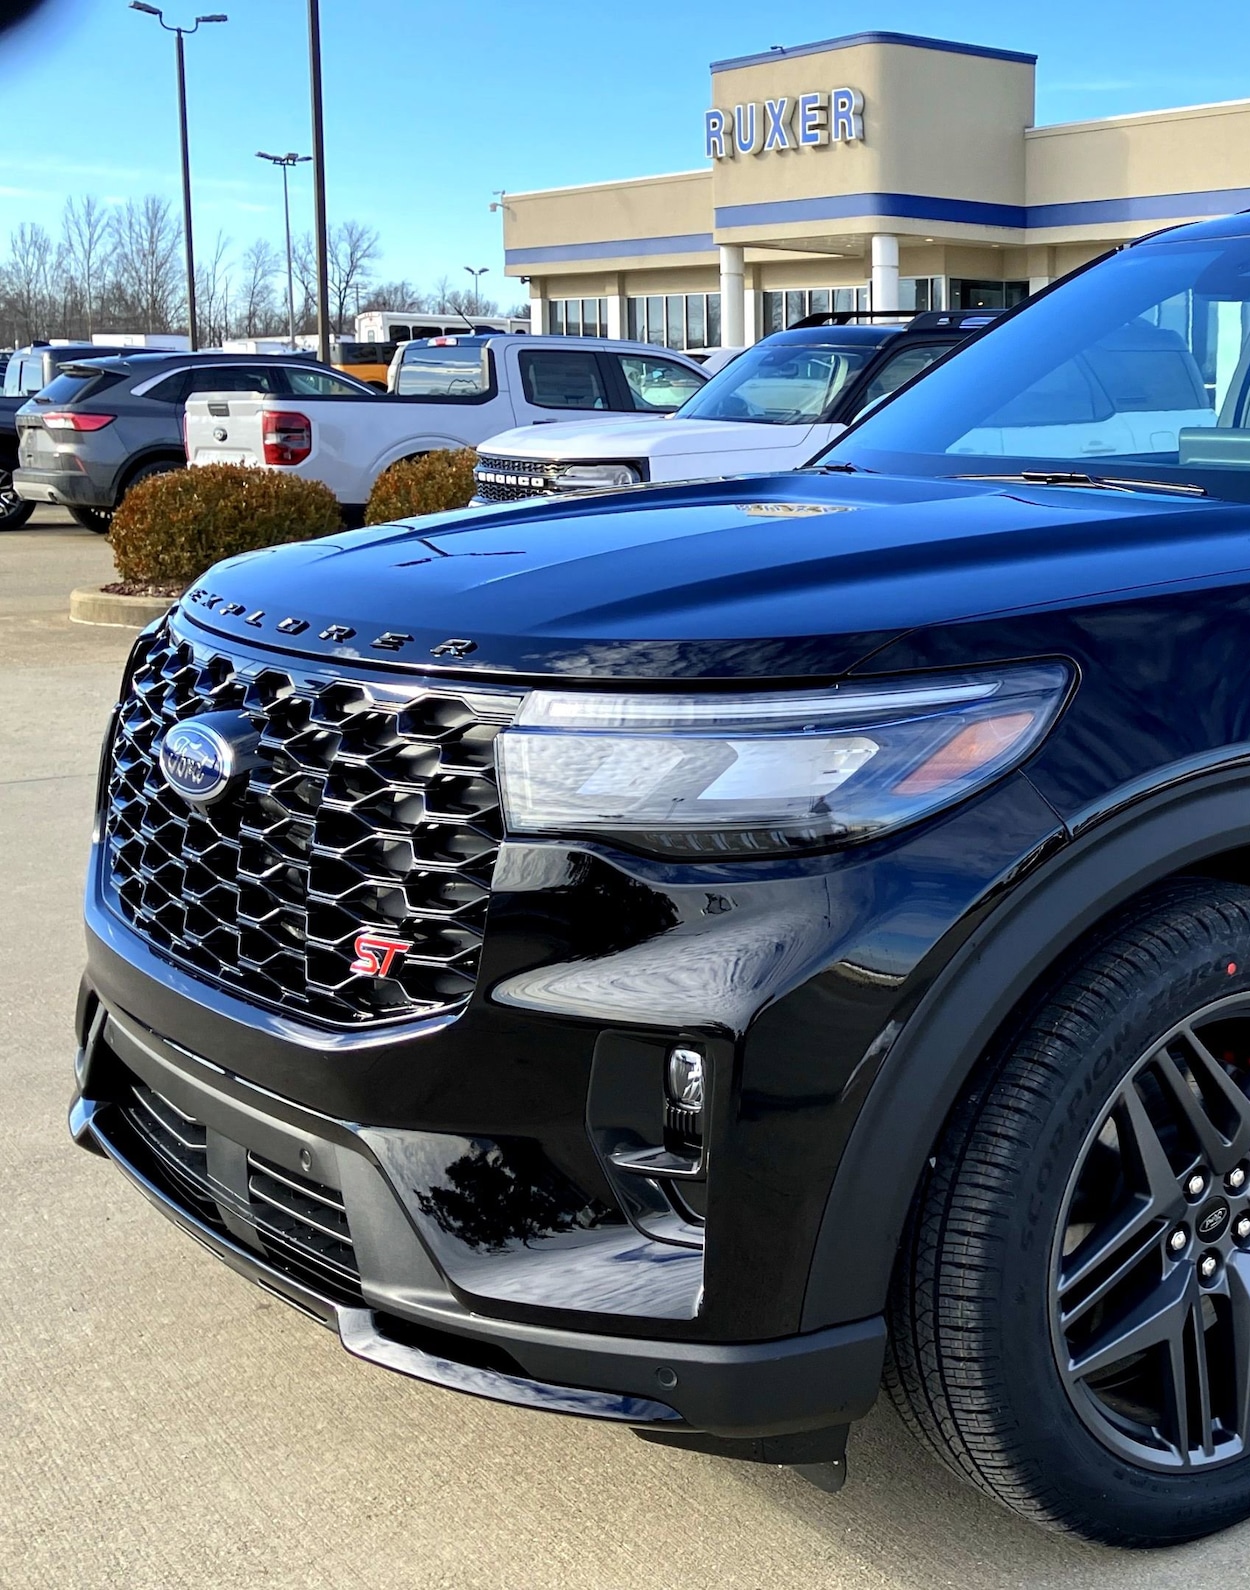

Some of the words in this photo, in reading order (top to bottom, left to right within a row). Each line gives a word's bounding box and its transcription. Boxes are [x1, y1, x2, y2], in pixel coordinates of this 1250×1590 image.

[704, 87, 865, 158] RUXER
[478, 472, 545, 487] BRONCO
[188, 588, 478, 659] EXPLORER
[349, 934, 412, 978] ST
